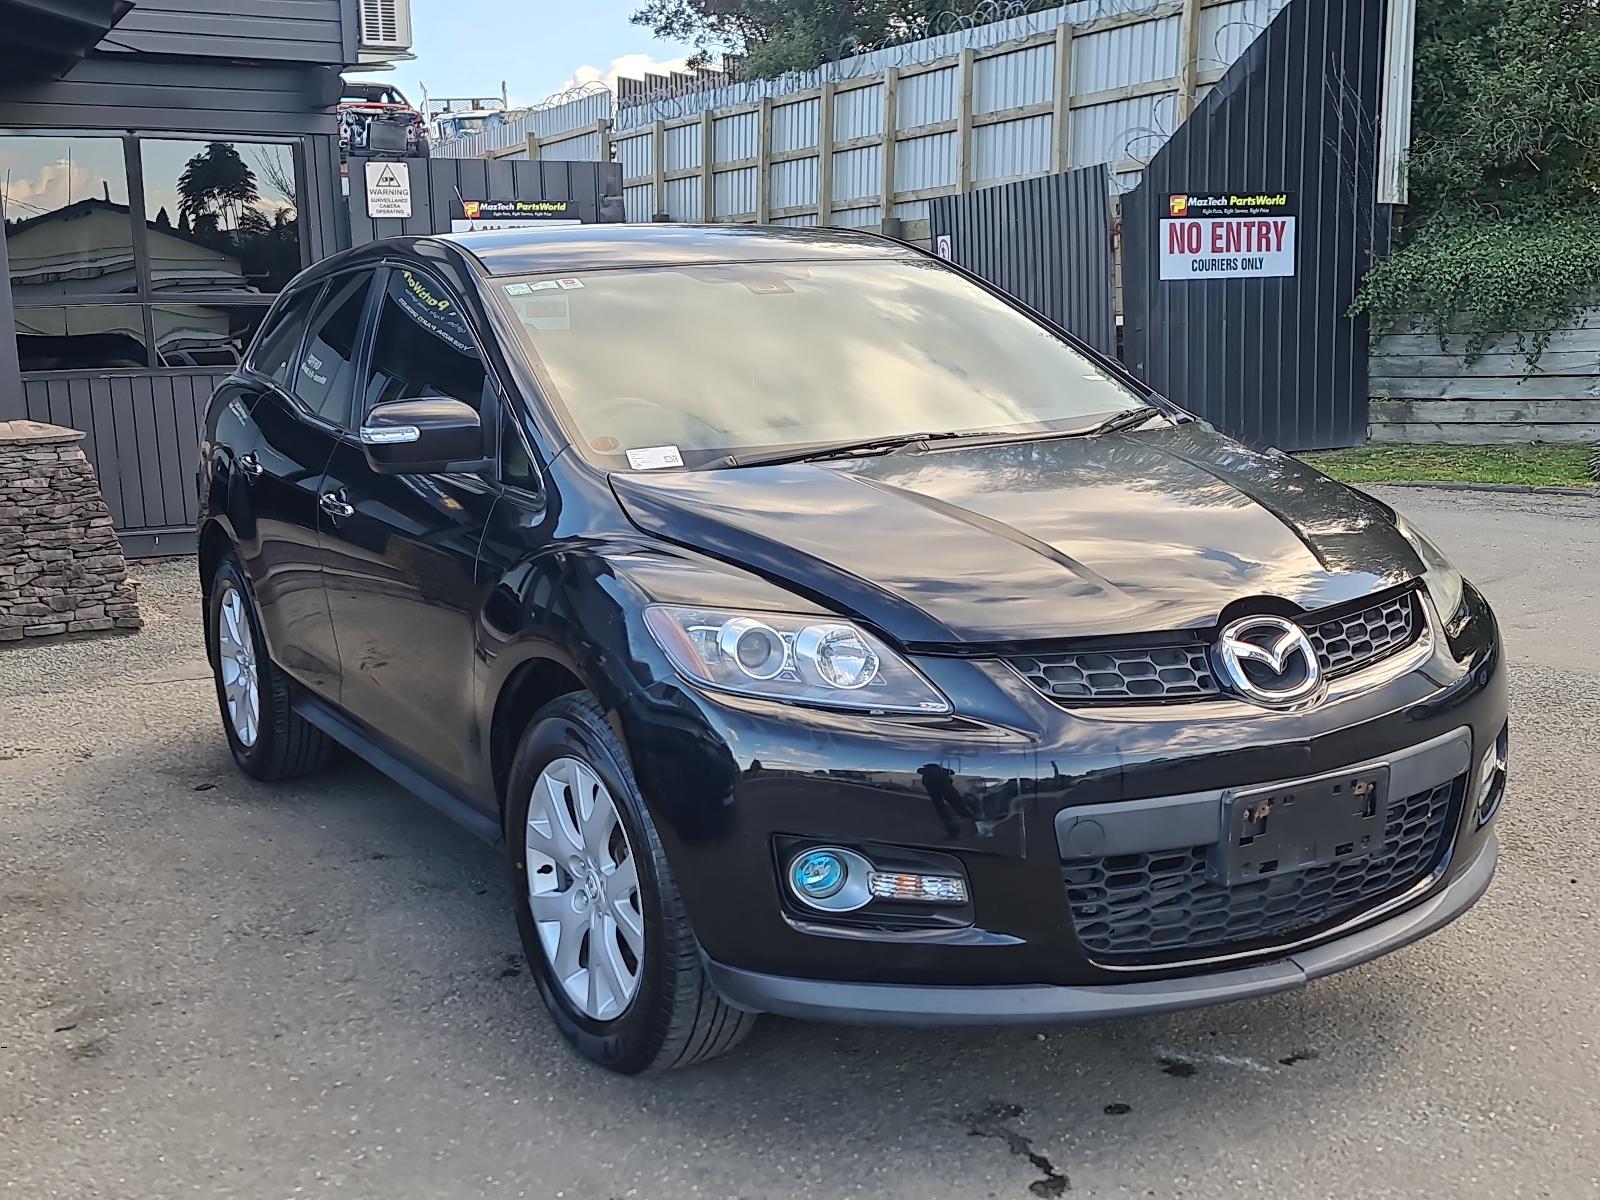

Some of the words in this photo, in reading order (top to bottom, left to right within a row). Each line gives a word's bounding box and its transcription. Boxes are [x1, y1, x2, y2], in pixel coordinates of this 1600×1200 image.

[369, 188, 409, 196] WARNING
[480, 202, 515, 211] MazTech
[516, 202, 567, 212] PartsWorld
[1187, 195, 1228, 207] MazTech
[1229, 194, 1287, 206] PartsWorld
[1168, 221, 1203, 255] NO
[1210, 220, 1287, 254] ENTRY
[1191, 258, 1239, 272] COURIERS
[1241, 256, 1265, 271] ONLY
